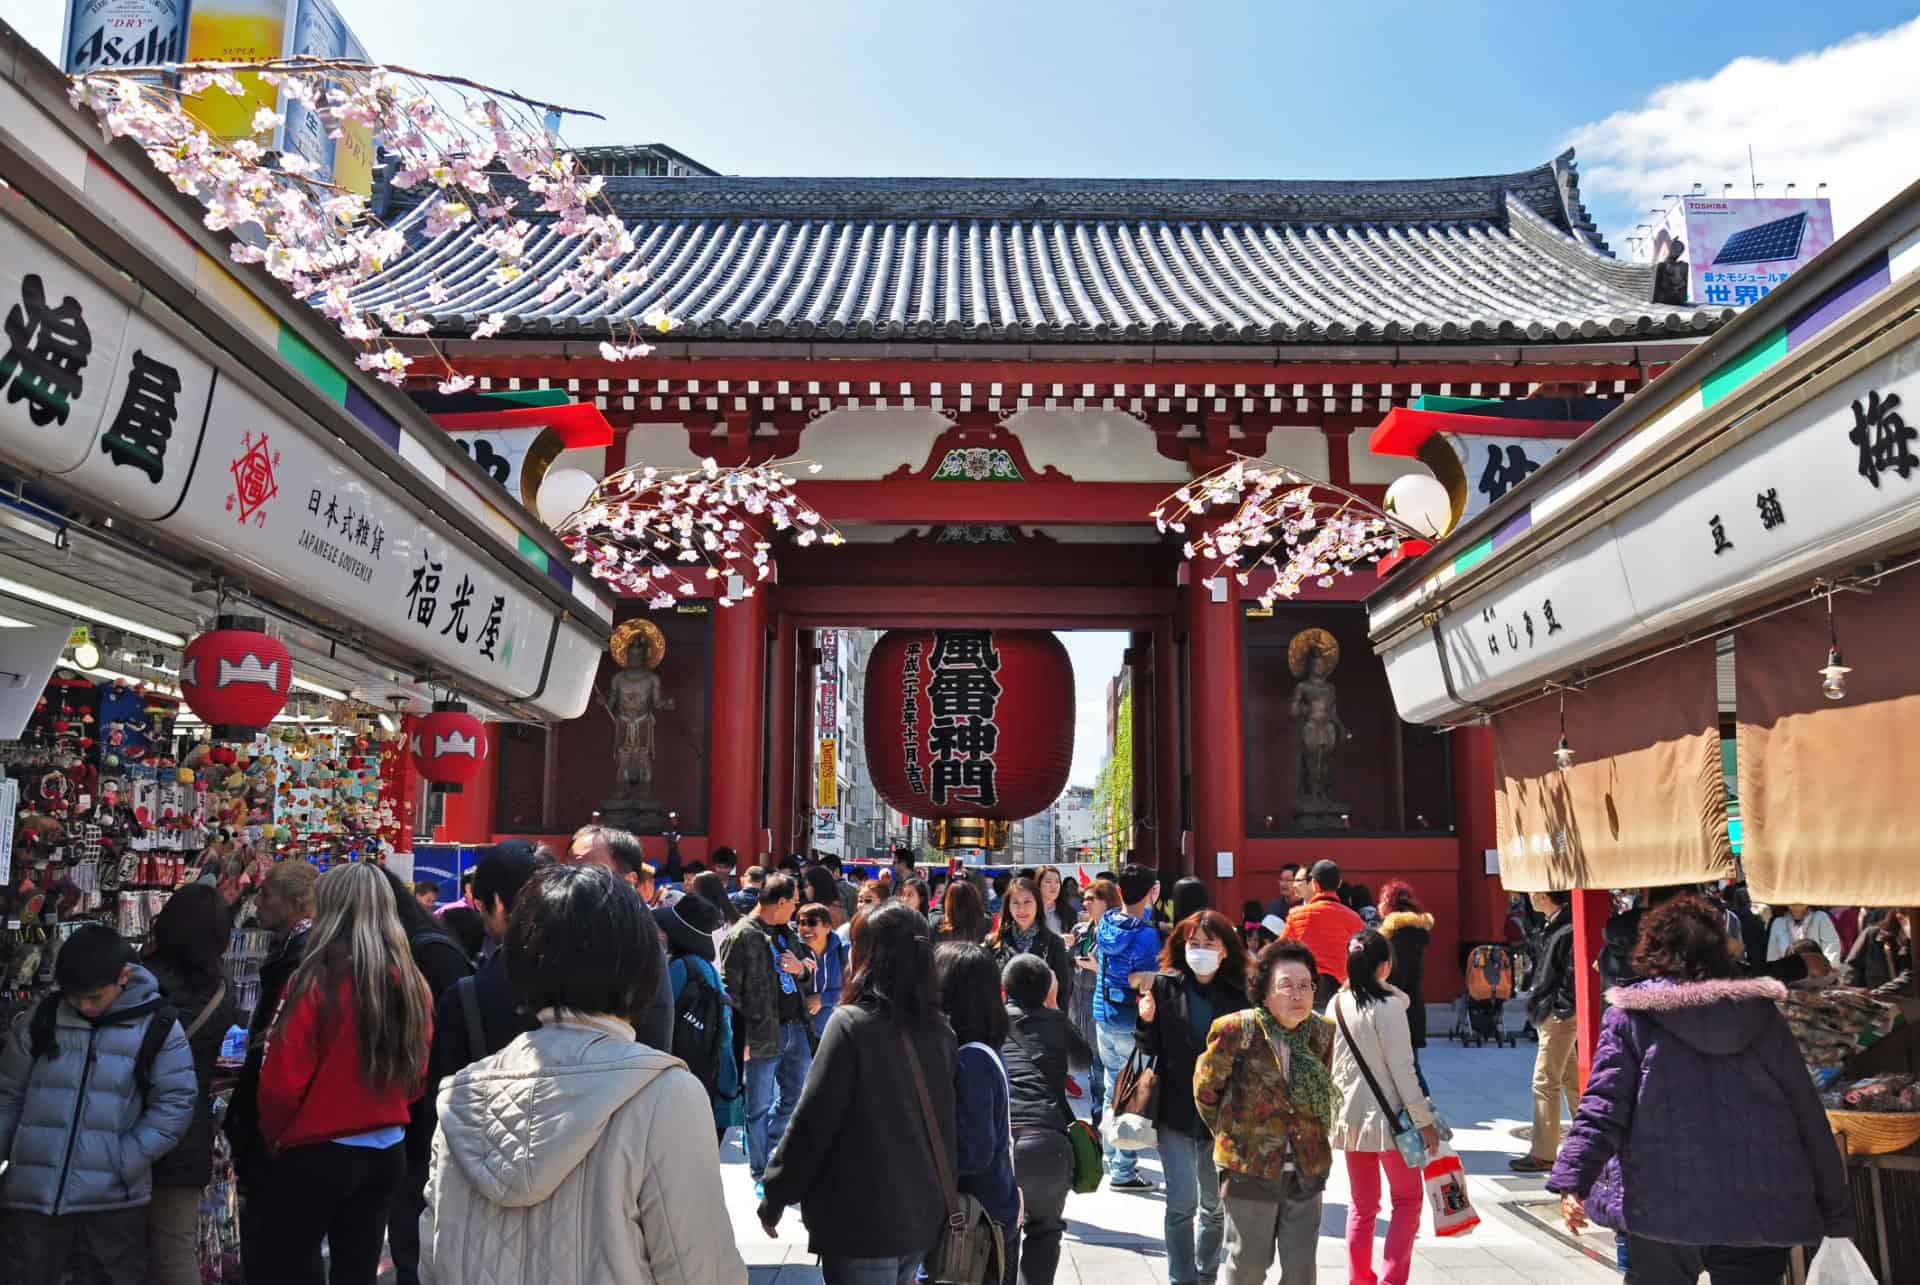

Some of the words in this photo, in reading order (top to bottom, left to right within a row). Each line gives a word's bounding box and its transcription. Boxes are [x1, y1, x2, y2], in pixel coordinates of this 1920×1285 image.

[75, 24, 178, 67] Asahi
[298, 529, 339, 564] JAPANESE
[337, 549, 374, 584] SOUVENIR
[406, 548, 505, 662] 福光屋
